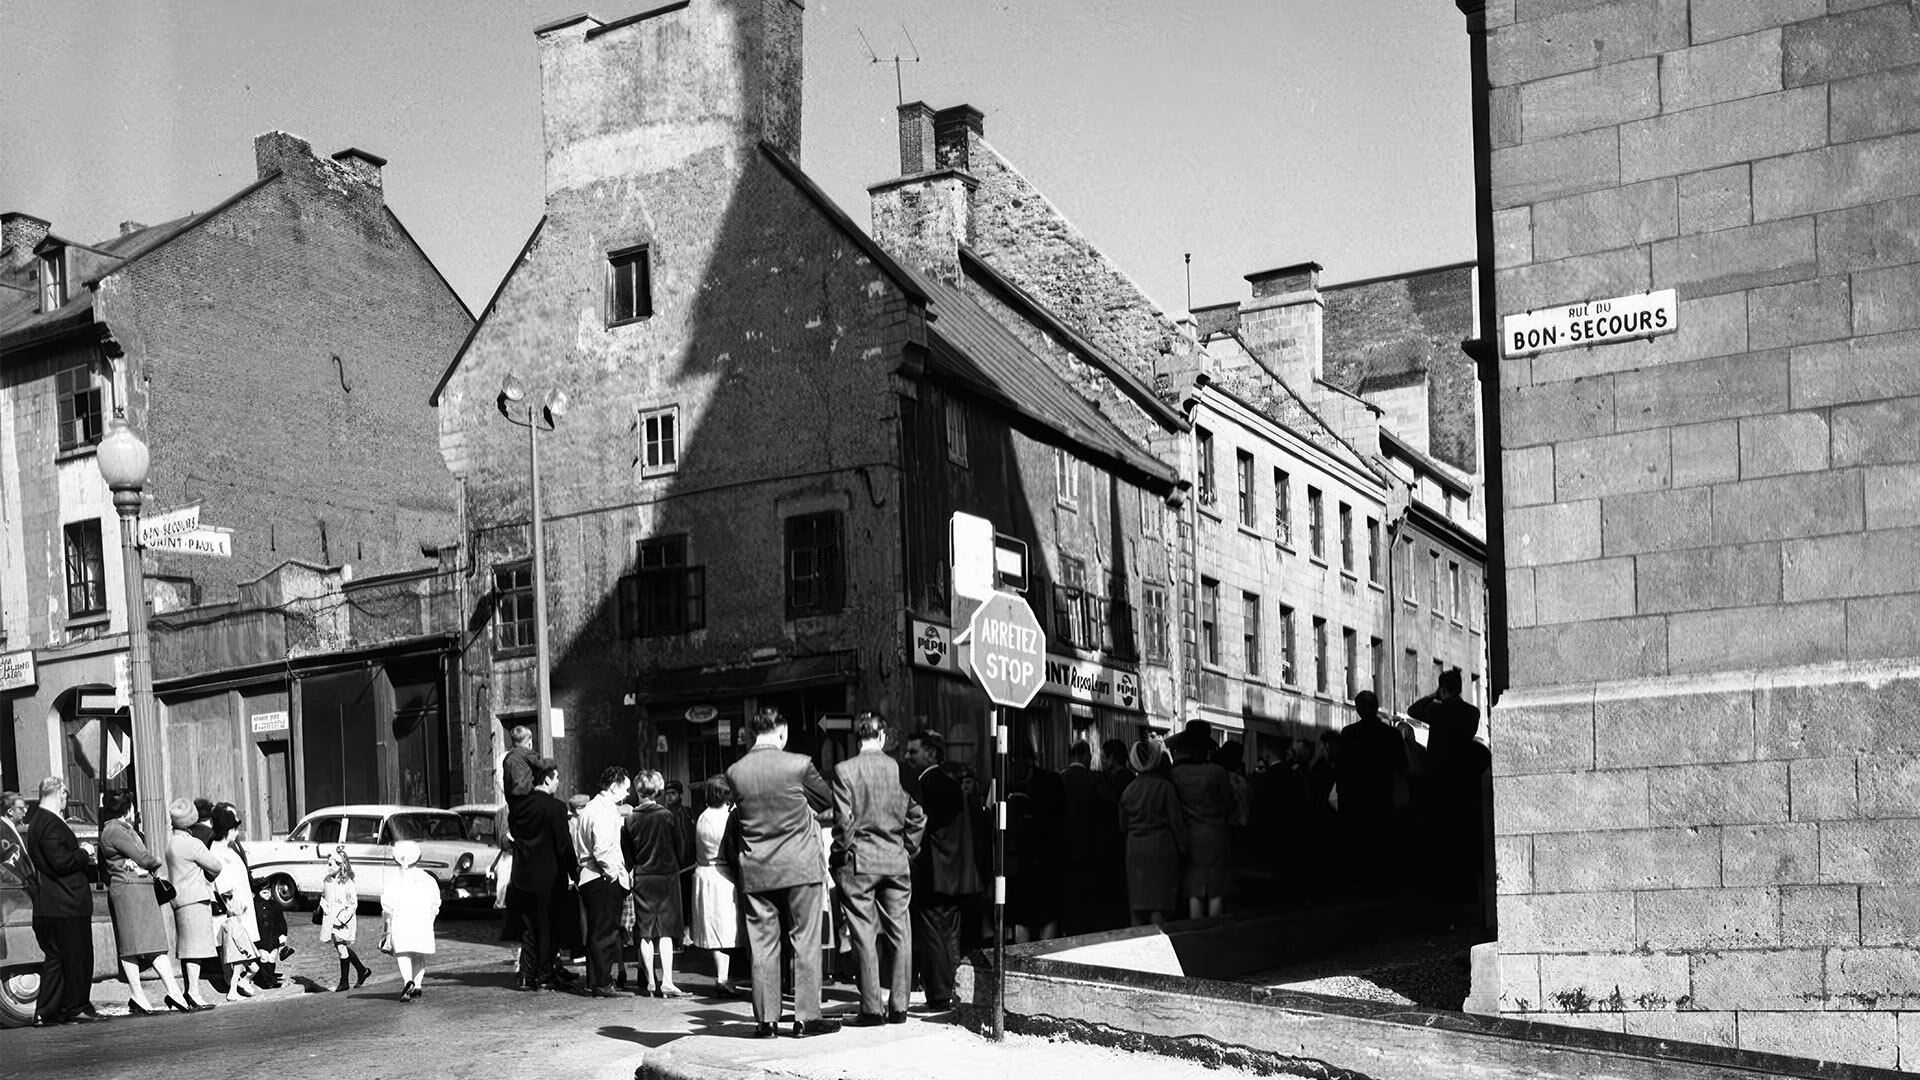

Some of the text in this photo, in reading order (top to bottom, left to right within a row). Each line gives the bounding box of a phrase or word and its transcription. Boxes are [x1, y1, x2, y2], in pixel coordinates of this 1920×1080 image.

[1568, 302, 1611, 318] RUE DU
[986, 652, 1034, 687] STOP
